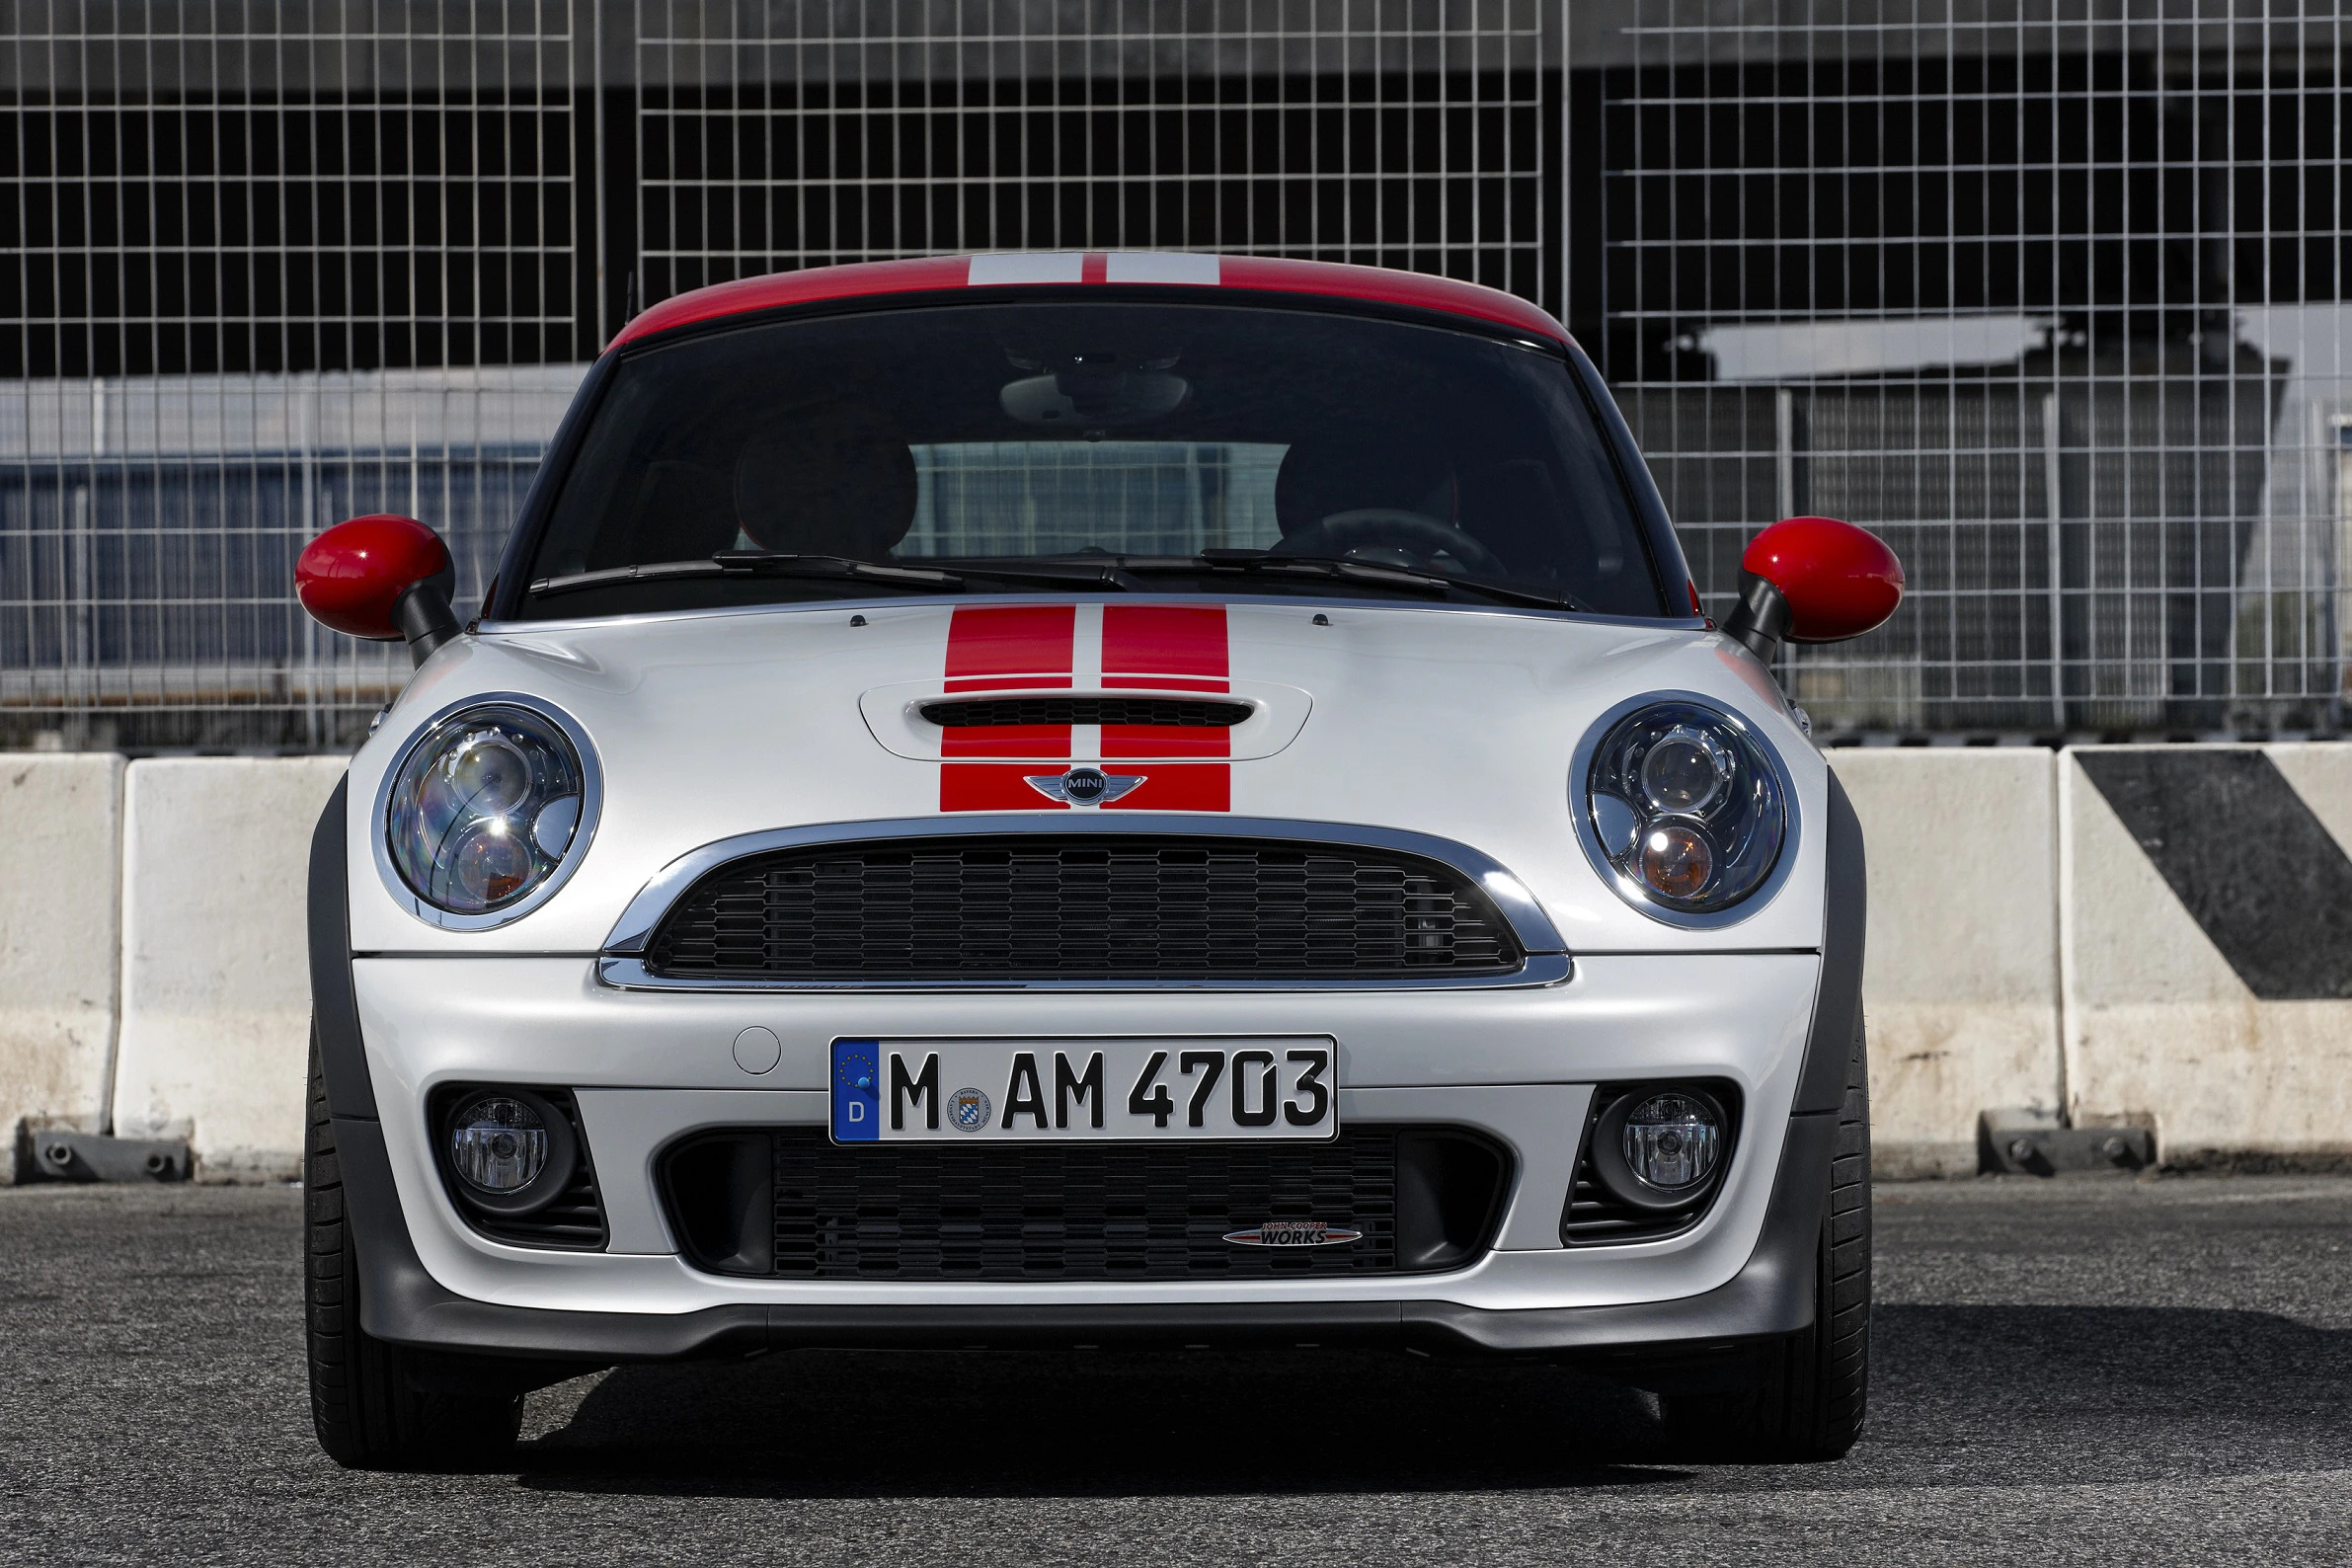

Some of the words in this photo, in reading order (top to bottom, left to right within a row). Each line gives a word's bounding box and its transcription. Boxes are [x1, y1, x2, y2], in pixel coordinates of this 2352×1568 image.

[1067, 778, 1103, 788] MINI
[890, 1053, 939, 1129] M
[1001, 1053, 1103, 1129] AM
[1129, 1050, 1328, 1127] 4703
[848, 1101, 865, 1123] D
[1261, 1230, 1326, 1244] WORKS
